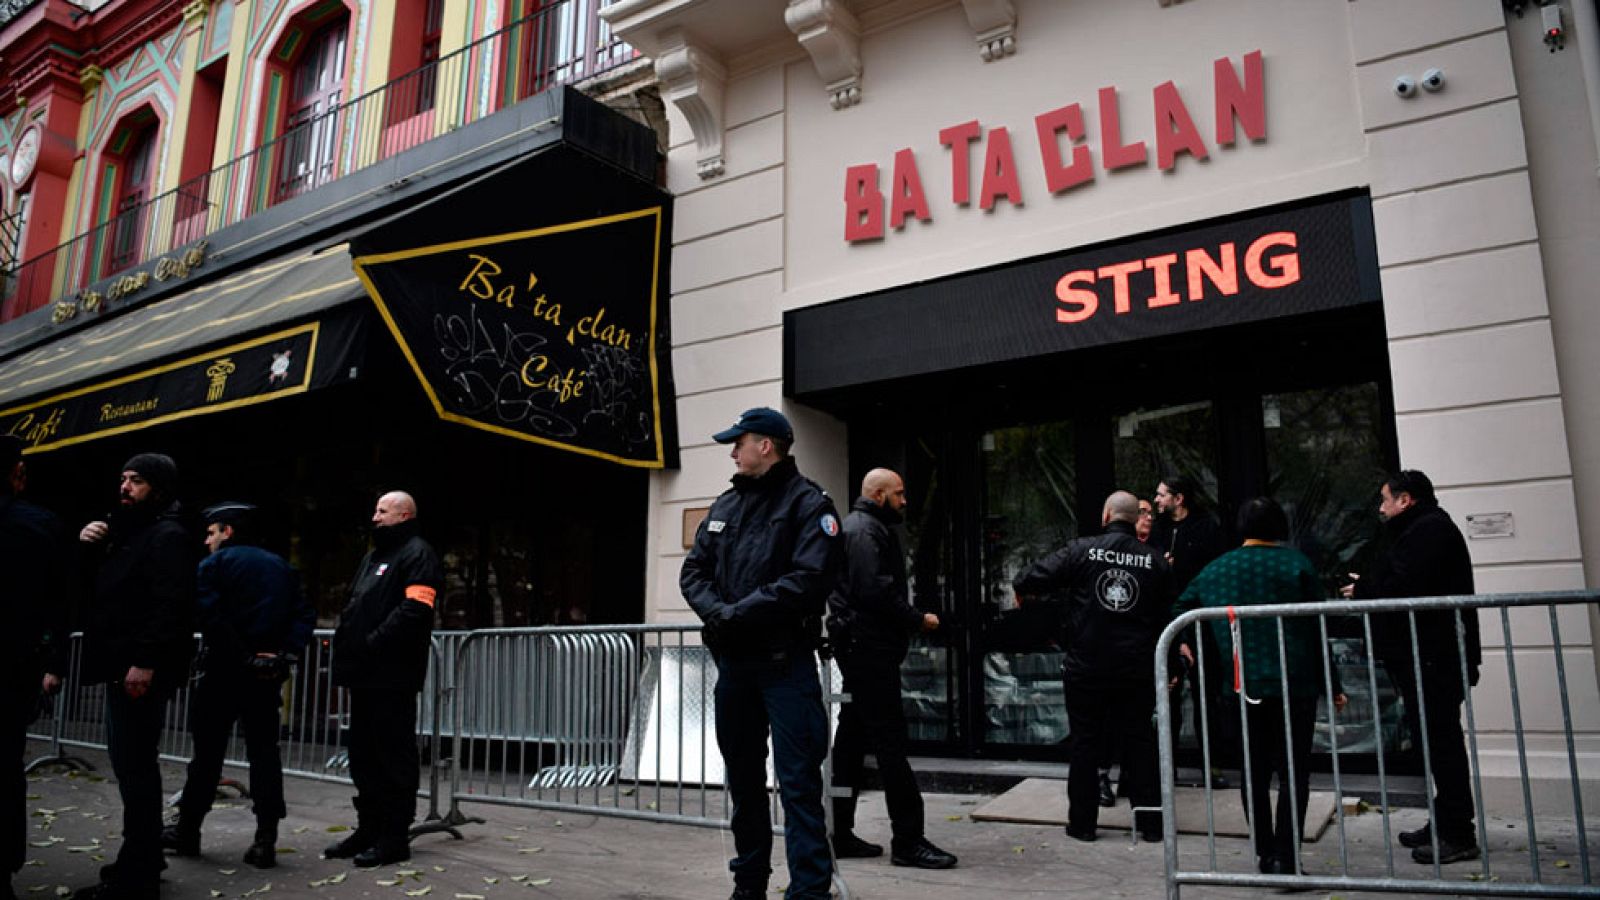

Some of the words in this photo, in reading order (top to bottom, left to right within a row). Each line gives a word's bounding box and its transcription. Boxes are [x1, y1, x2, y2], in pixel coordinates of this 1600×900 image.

[1055, 230, 1302, 325] STING
[521, 356, 587, 405] Café
[98, 394, 161, 424] Restaurant
